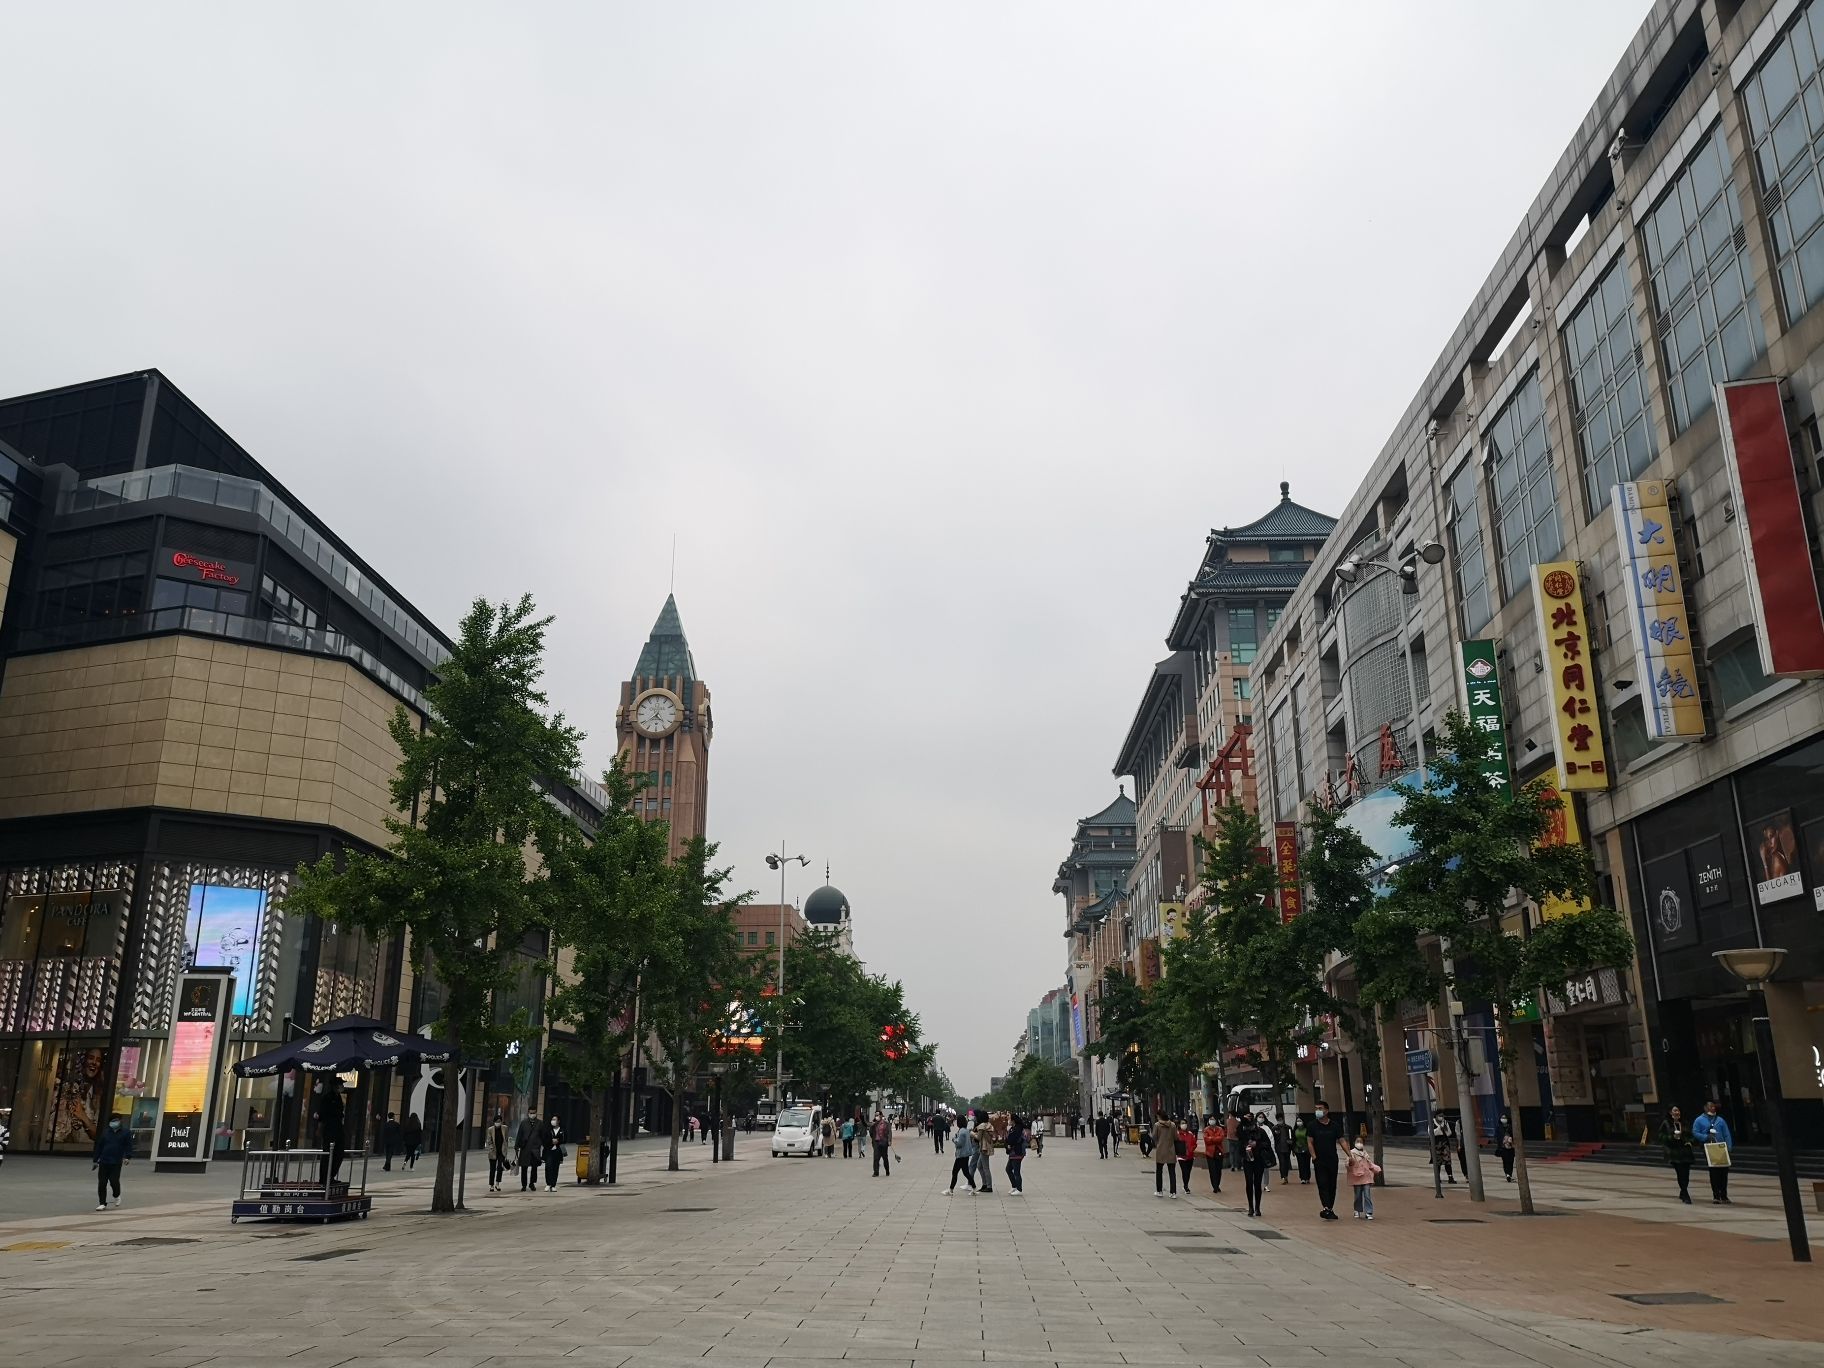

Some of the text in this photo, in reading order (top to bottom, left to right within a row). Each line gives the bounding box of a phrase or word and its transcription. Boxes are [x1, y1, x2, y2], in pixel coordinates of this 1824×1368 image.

[173, 552, 226, 571] Cheesecake
[198, 566, 240, 585] Factory
[1638, 518, 1695, 699] 大明眼镜
[1551, 602, 1594, 752] 北京同仁堂
[1698, 867, 1723, 884] ZENITH
[1758, 873, 1801, 893] BVLGARI
[1076, 962, 1090, 970] apm
[259, 1204, 305, 1214] 值勤岗台
